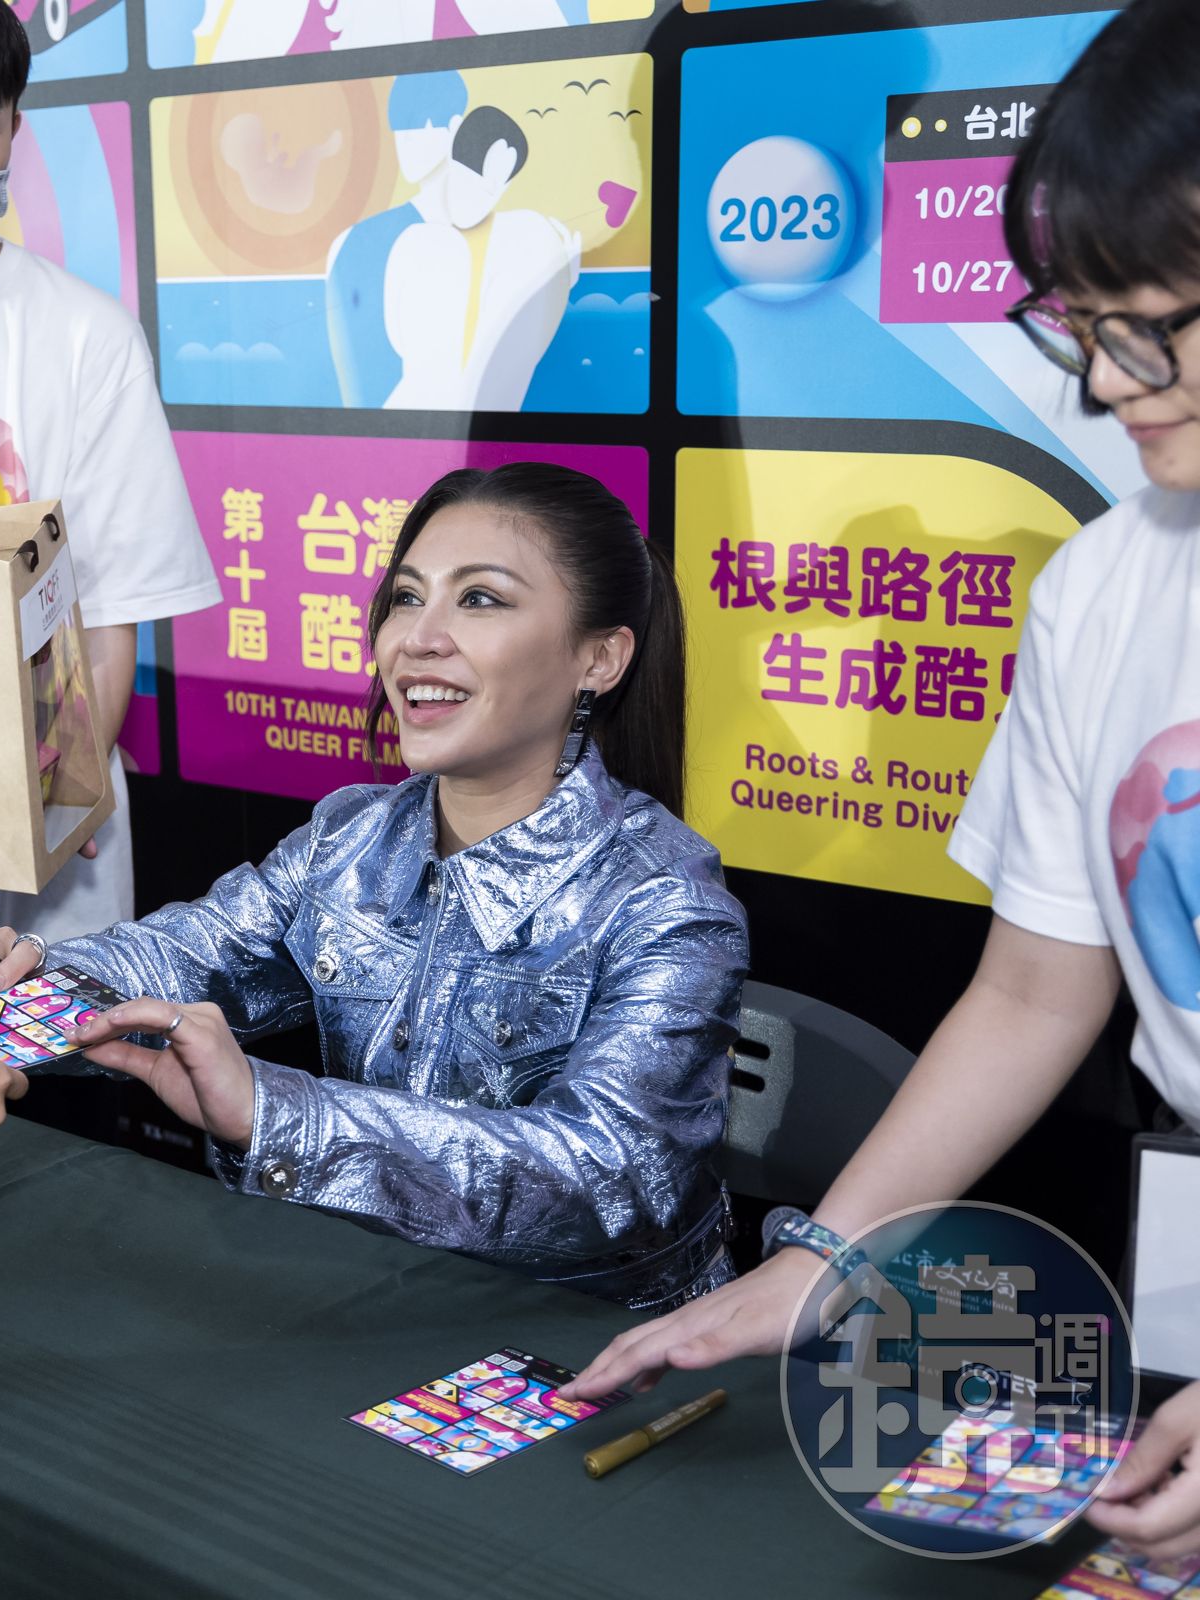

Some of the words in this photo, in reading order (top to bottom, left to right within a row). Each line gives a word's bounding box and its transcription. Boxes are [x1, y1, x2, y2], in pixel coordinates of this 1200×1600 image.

[964, 102, 1036, 140] 台北
[719, 194, 840, 242] 2023
[912, 260, 1013, 293] 10/27
[709, 537, 1016, 628] 根與路徑
[299, 593, 377, 678] 酷
[225, 690, 276, 718] 10TH
[281, 697, 367, 731] TAIWAN
[265, 725, 342, 758] QUEER
[348, 738, 402, 767] FIM
[745, 743, 839, 780] Roots
[851, 756, 874, 785] &
[887, 760, 975, 797] Rout
[730, 780, 883, 829] Queering
[895, 800, 960, 833] Div
